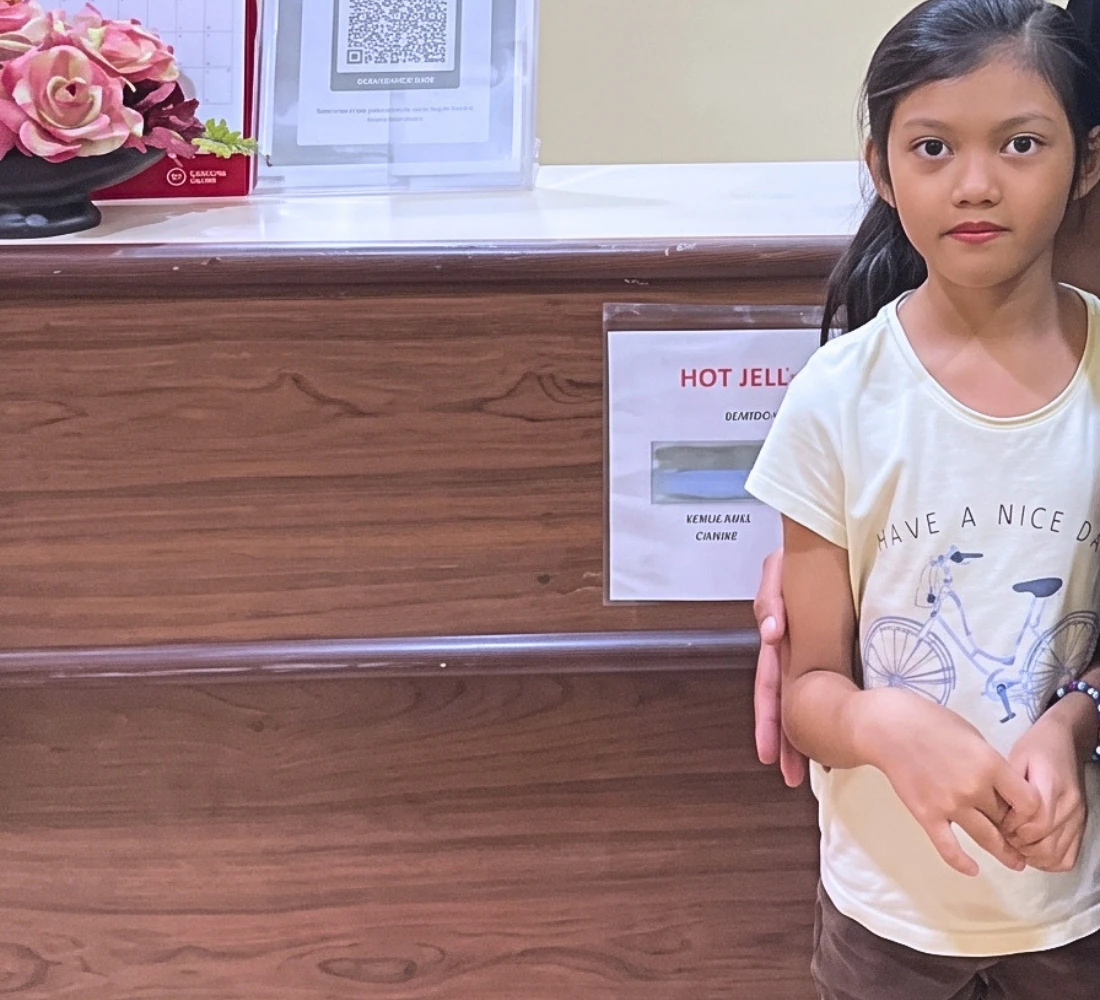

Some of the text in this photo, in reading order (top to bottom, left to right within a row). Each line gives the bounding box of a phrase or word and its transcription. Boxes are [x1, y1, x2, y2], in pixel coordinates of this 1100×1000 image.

[681, 368, 795, 387] HOT JELL
[876, 512, 940, 551] HAVE
[961, 506, 977, 528] A
[998, 504, 1064, 533] NICE
